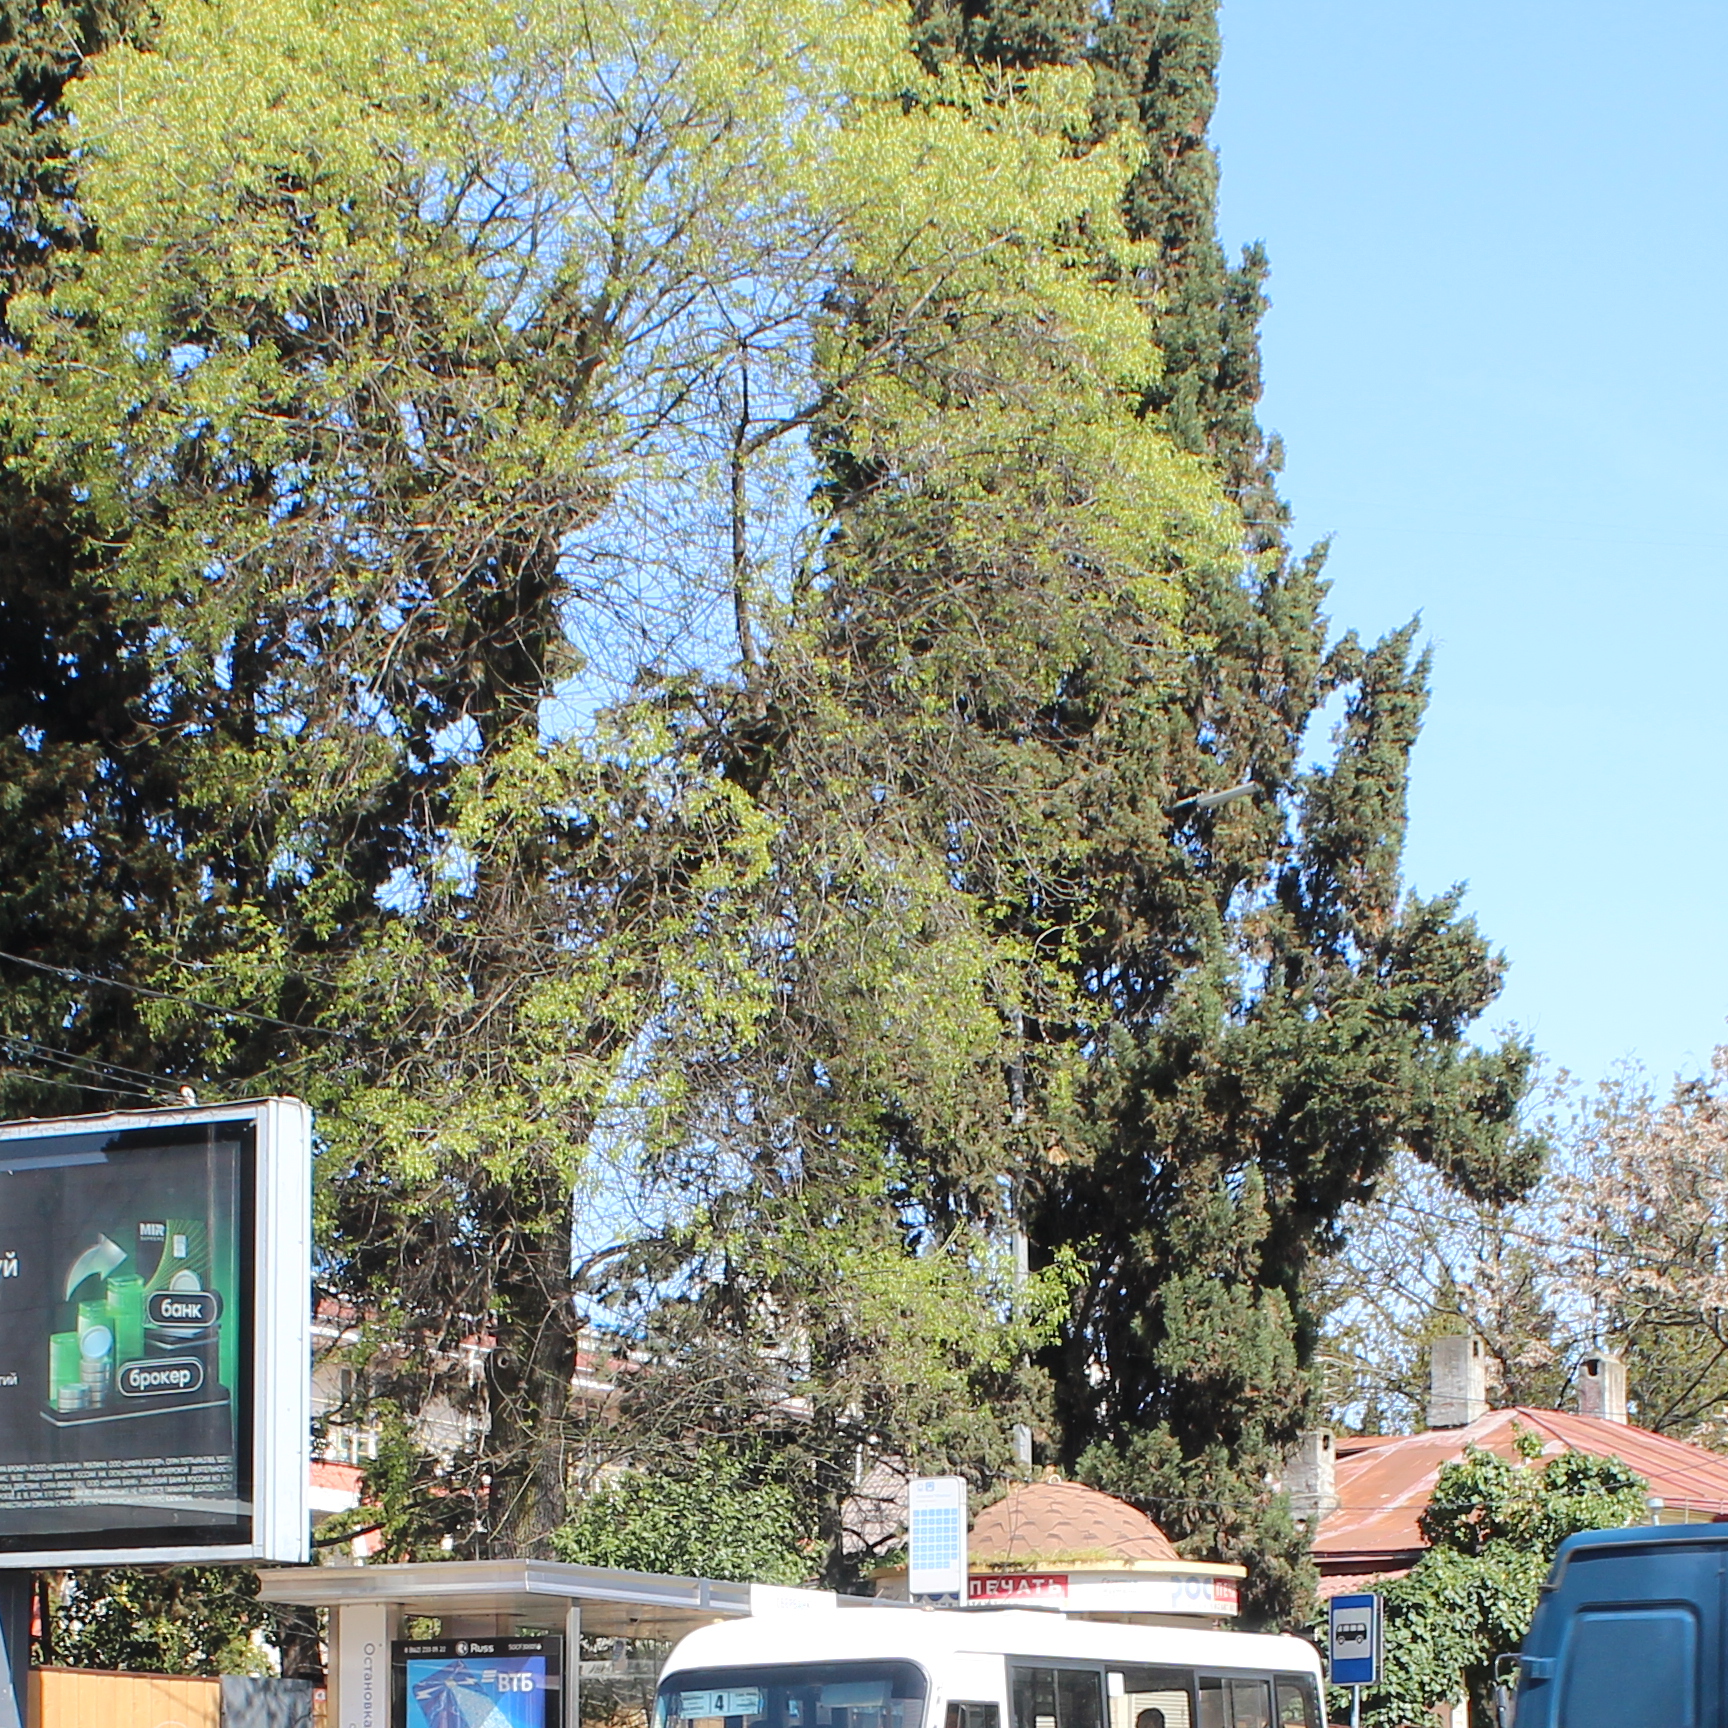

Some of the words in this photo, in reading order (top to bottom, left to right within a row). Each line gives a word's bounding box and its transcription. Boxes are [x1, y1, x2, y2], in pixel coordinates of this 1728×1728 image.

[139, 1223, 165, 1237] MIR
[160, 1298, 202, 1319] банк
[129, 1368, 191, 1391] брокер
[969, 1578, 1063, 1596] ПЕЧАТЬ
[469, 1642, 495, 1654] Russ
[362, 1642, 376, 1728] Остановка
[498, 1672, 534, 1693] ВТБ
[714, 1694, 725, 1712] 4
